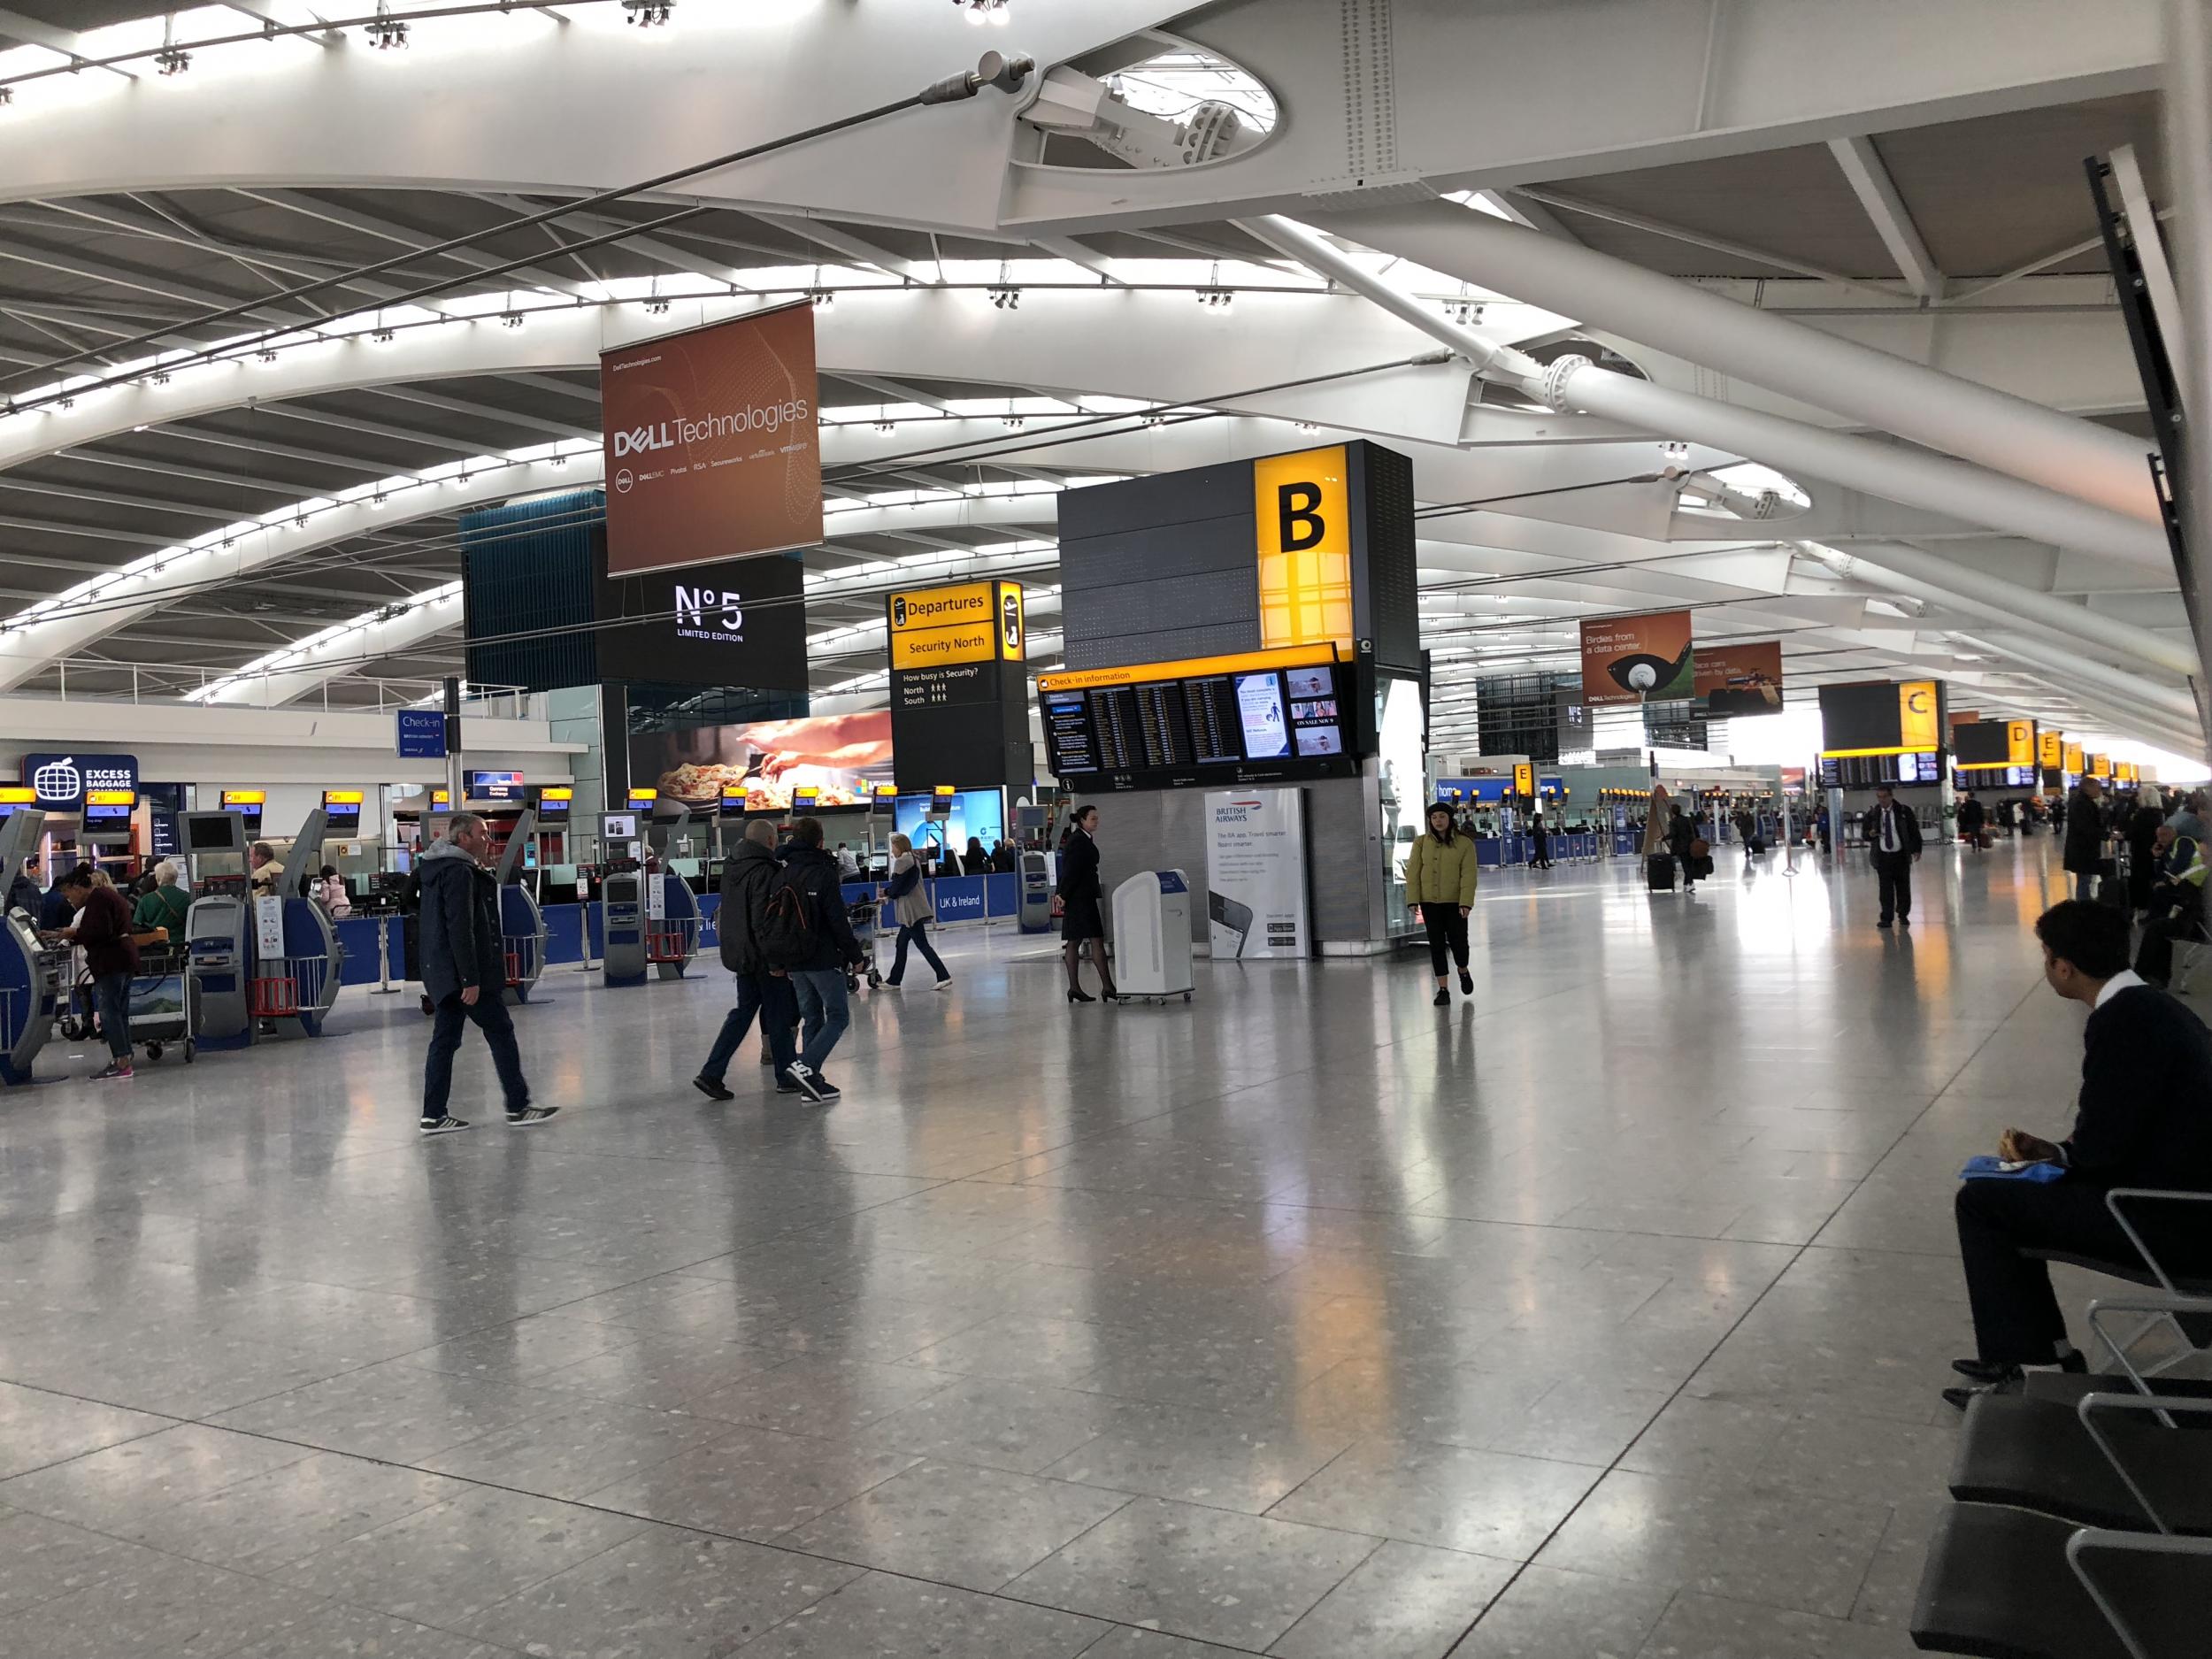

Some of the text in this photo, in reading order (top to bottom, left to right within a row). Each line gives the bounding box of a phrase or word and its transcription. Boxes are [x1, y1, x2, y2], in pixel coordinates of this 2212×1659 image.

[614, 398, 808, 457] DELL Technologies
[693, 462, 706, 471] RSA
[1278, 481, 1325, 553] B
[909, 596, 984, 617] Departures
[677, 628, 743, 642] LIMITED EDITION
[1586, 633, 1634, 644] Birdies from
[910, 635, 984, 654] Security North
[903, 673, 919, 682] How
[921, 672, 937, 681] busy
[946, 667, 978, 679] Security?
[1050, 672, 1130, 686] Check-in information
[903, 686, 924, 695] North
[904, 696, 925, 705] South
[1909, 691, 1927, 714] C
[403, 716, 440, 727] Check-in
[2014, 726, 2027, 741] D
[2046, 737, 2053, 749] E
[86, 770, 131, 779] EXCESS
[1520, 768, 1526, 779] E
[1216, 806, 1247, 815] BRITISH
[940, 894, 979, 909] UK & Ireland
